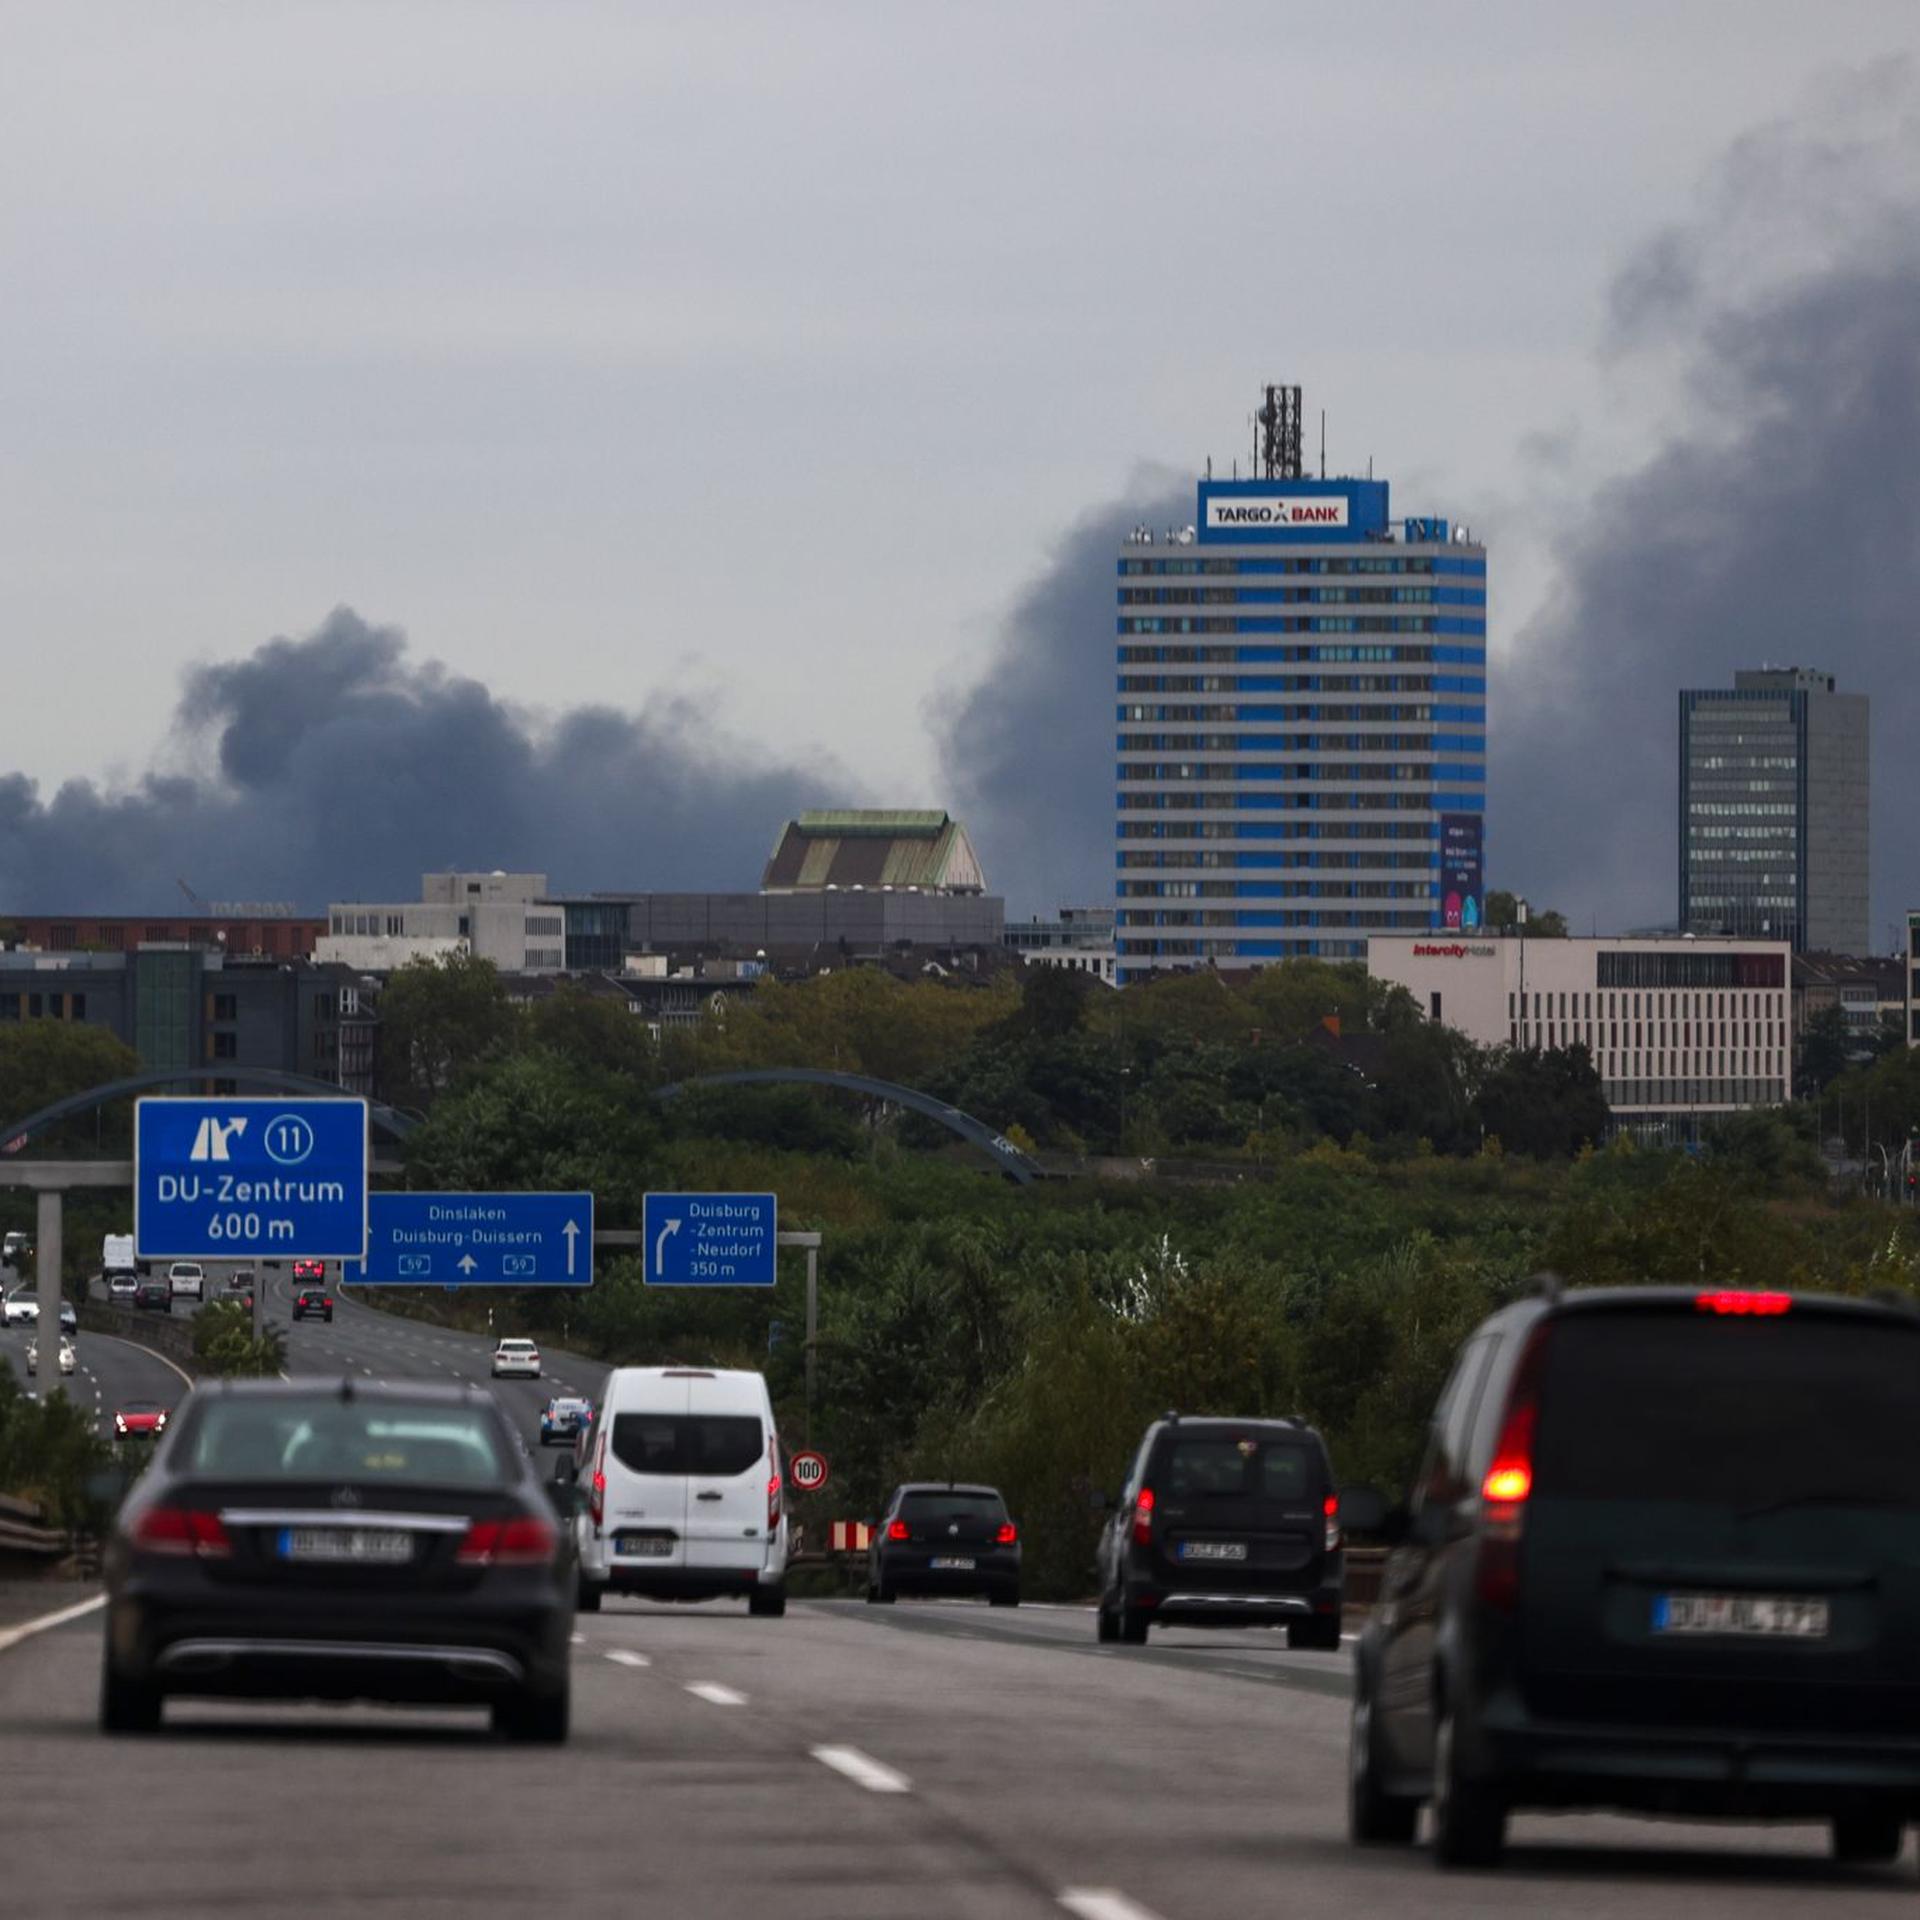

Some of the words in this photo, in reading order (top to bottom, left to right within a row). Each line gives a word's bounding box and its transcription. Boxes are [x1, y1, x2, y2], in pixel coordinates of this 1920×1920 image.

[1215, 507, 1272, 522] TARGO
[1291, 507, 1339, 522] BANK
[278, 1126, 301, 1154] 11
[158, 1175, 344, 1202] DU-Zentrum
[429, 1205, 506, 1220] Dinslaken
[689, 1202, 760, 1221] Duisburg
[208, 1213, 260, 1239] 600
[268, 1219, 295, 1239] m
[690, 1223, 764, 1237] -Zentrum
[392, 1228, 543, 1246] Duisburg-Duissern
[690, 1242, 761, 1257] -Neudorf
[407, 1258, 423, 1271] 59
[511, 1258, 527, 1271] 59
[690, 1261, 718, 1276] 350
[720, 1264, 735, 1276] m
[797, 1461, 819, 1479] 100
